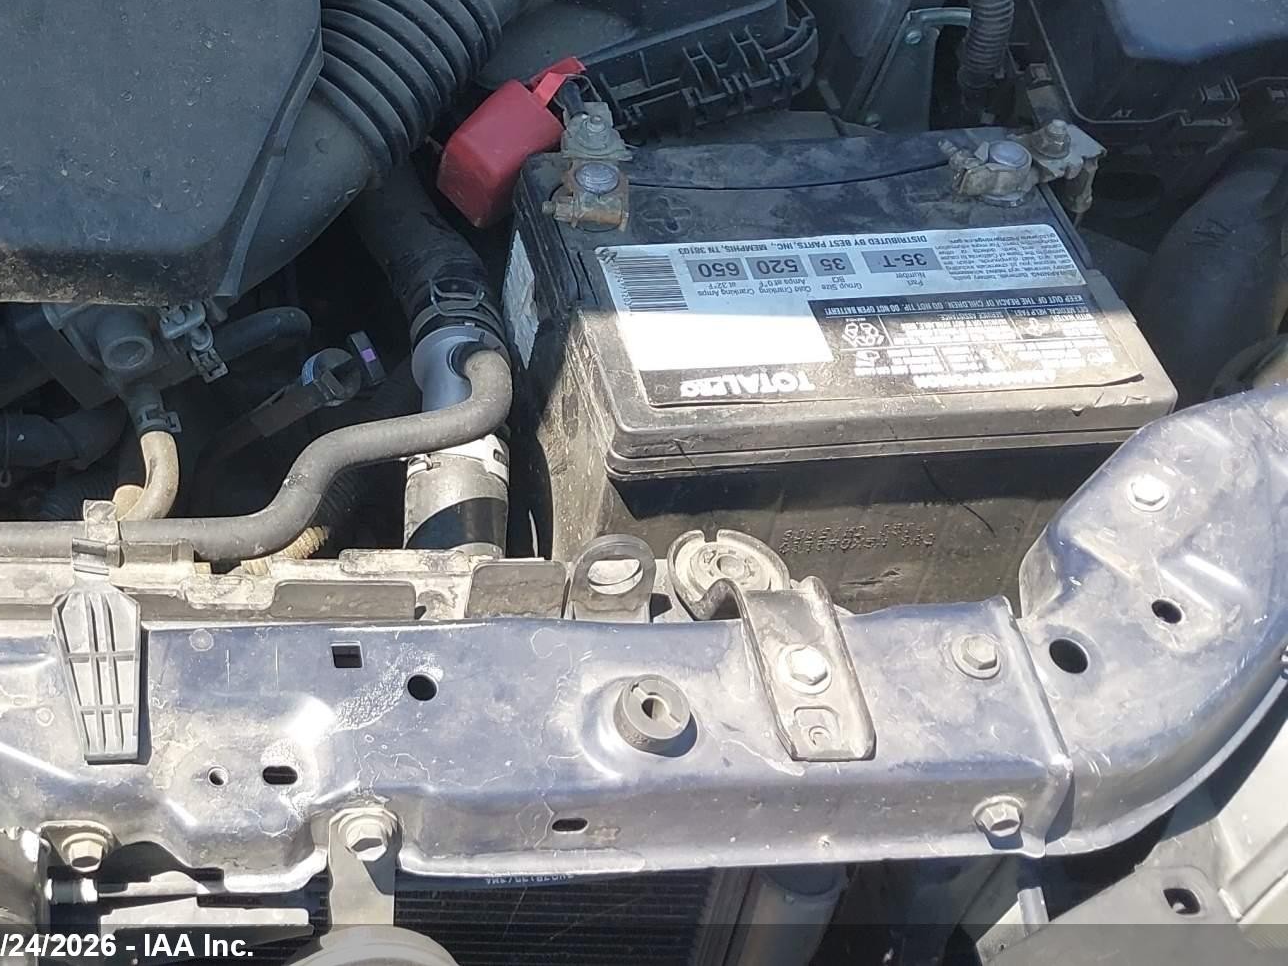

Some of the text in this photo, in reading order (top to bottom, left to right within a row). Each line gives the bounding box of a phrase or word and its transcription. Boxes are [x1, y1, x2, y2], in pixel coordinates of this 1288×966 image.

[794, 240, 827, 249] PARTS,
[829, 239, 851, 248] BEST
[854, 238, 864, 246] BY
[868, 235, 927, 245] DISTRIBUTED
[678, 247, 706, 255] 38103
[708, 246, 720, 254] TN
[721, 244, 767, 253] MEMPHIS,
[819, 258, 846, 272] 35
[883, 253, 927, 268] 35-T
[698, 263, 740, 278] 650
[756, 259, 799, 275] 520
[839, 281, 863, 290] Group
[907, 279, 923, 287] Part
[697, 288, 755, 297] Cranking Amps
[759, 285, 812, 295] Cold Cranking
[985, 299, 994, 307] OF
[995, 298, 1020, 306] REACH
[1020, 297, 1035, 305] THE
[1037, 296, 1046, 304] OF
[1047, 295, 1062, 303] OUT
[1064, 294, 1082, 303] KEEP
[823, 306, 856, 315] BATTERY!
[856, 305, 874, 314] OPEN
[875, 305, 890, 313] NOT
[890, 304, 900, 312] DO
[917, 302, 932, 310] NOT
[932, 302, 944, 310] DO
[679, 370, 816, 398] TOTALPRO
